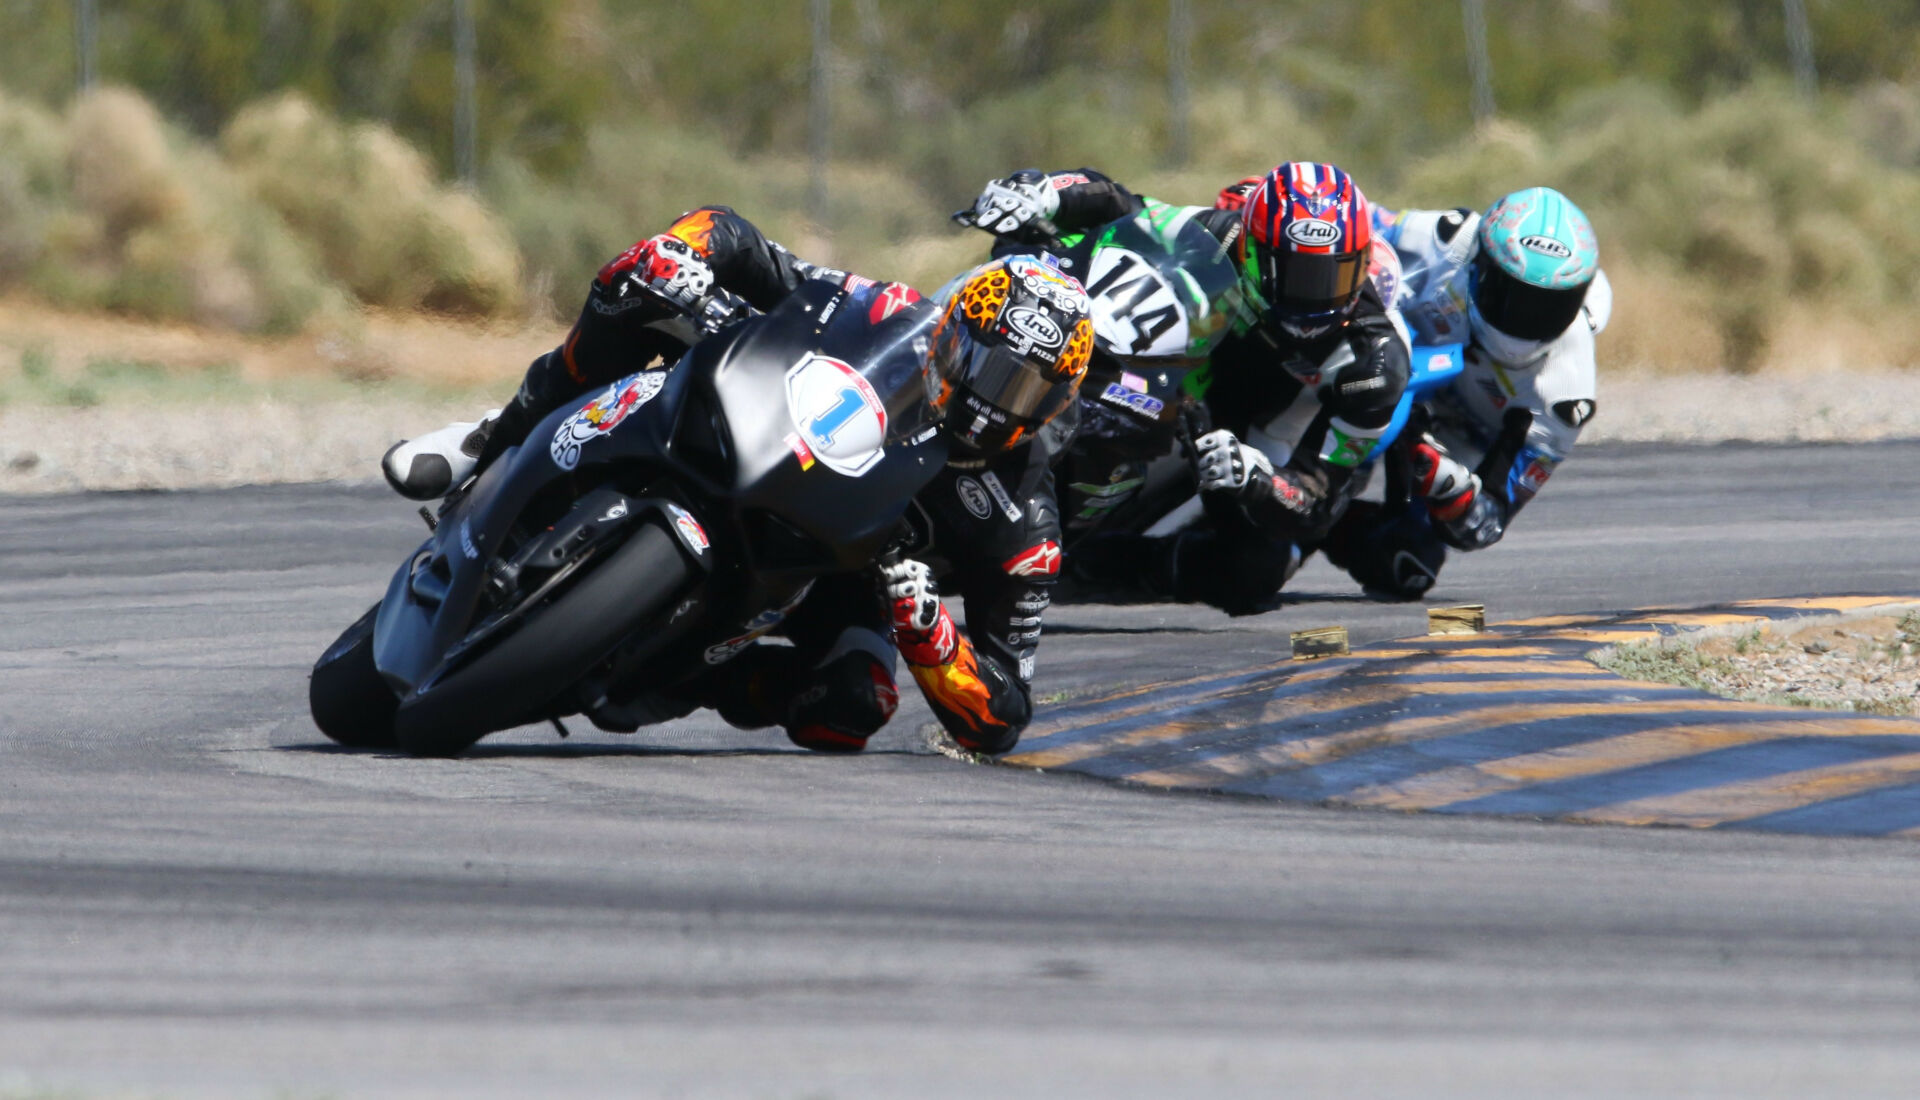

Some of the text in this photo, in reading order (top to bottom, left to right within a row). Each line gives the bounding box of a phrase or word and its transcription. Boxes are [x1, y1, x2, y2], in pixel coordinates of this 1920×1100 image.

[1291, 222, 1333, 238] Arai
[1524, 238, 1568, 255] HJC
[1086, 254, 1181, 355] 144
[1012, 312, 1058, 342] Arai
[1031, 346, 1056, 363] PIZZA
[806, 386, 868, 447] 1
[961, 481, 987, 514] Arai
